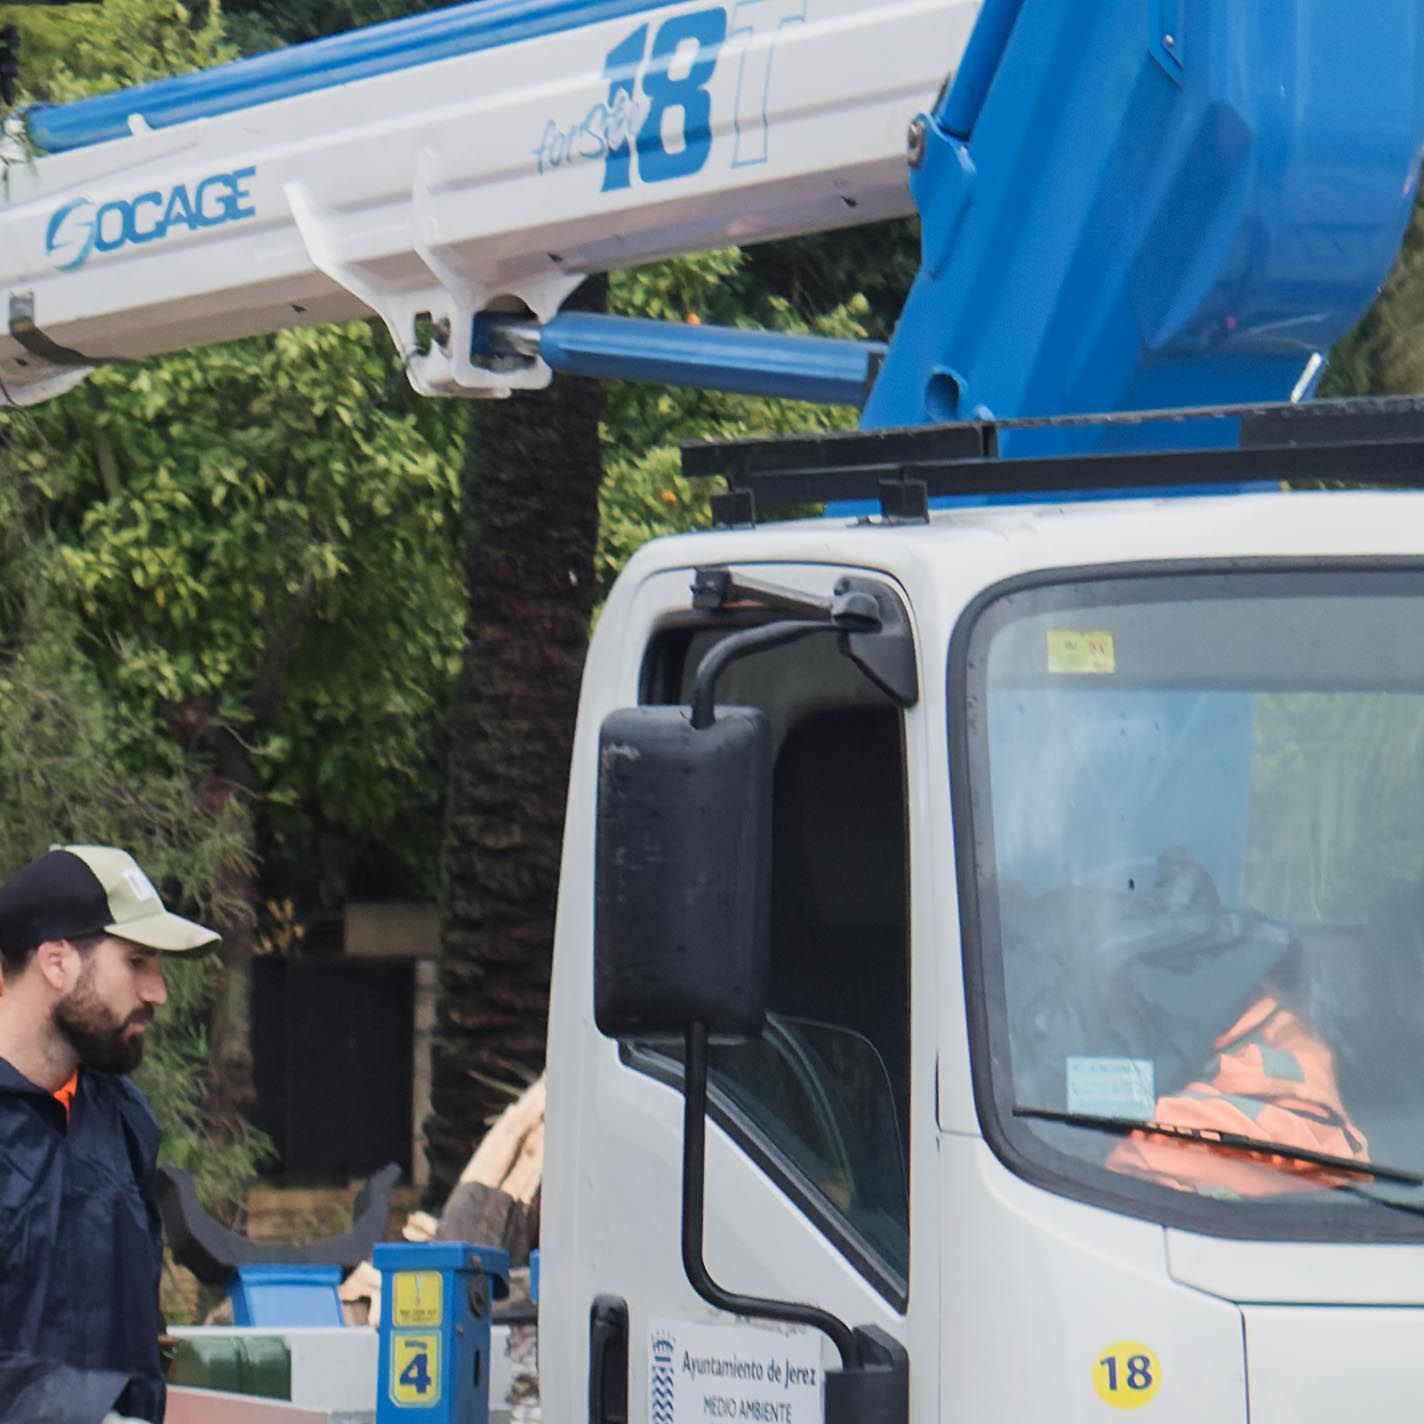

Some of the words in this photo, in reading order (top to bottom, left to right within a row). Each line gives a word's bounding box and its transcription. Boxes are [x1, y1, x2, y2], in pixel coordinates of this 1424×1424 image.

[45, 165, 257, 273] SOCAGE
[399, 1353, 432, 1395] 4
[681, 1350, 763, 1382] Ayuntamiento
[767, 1357, 782, 1384] de
[784, 1358, 817, 1390] Jerez
[1100, 1354, 1153, 1392] 18
[703, 1395, 737, 1418] MEDIO
[739, 1399, 792, 1424] AMBIENTE
